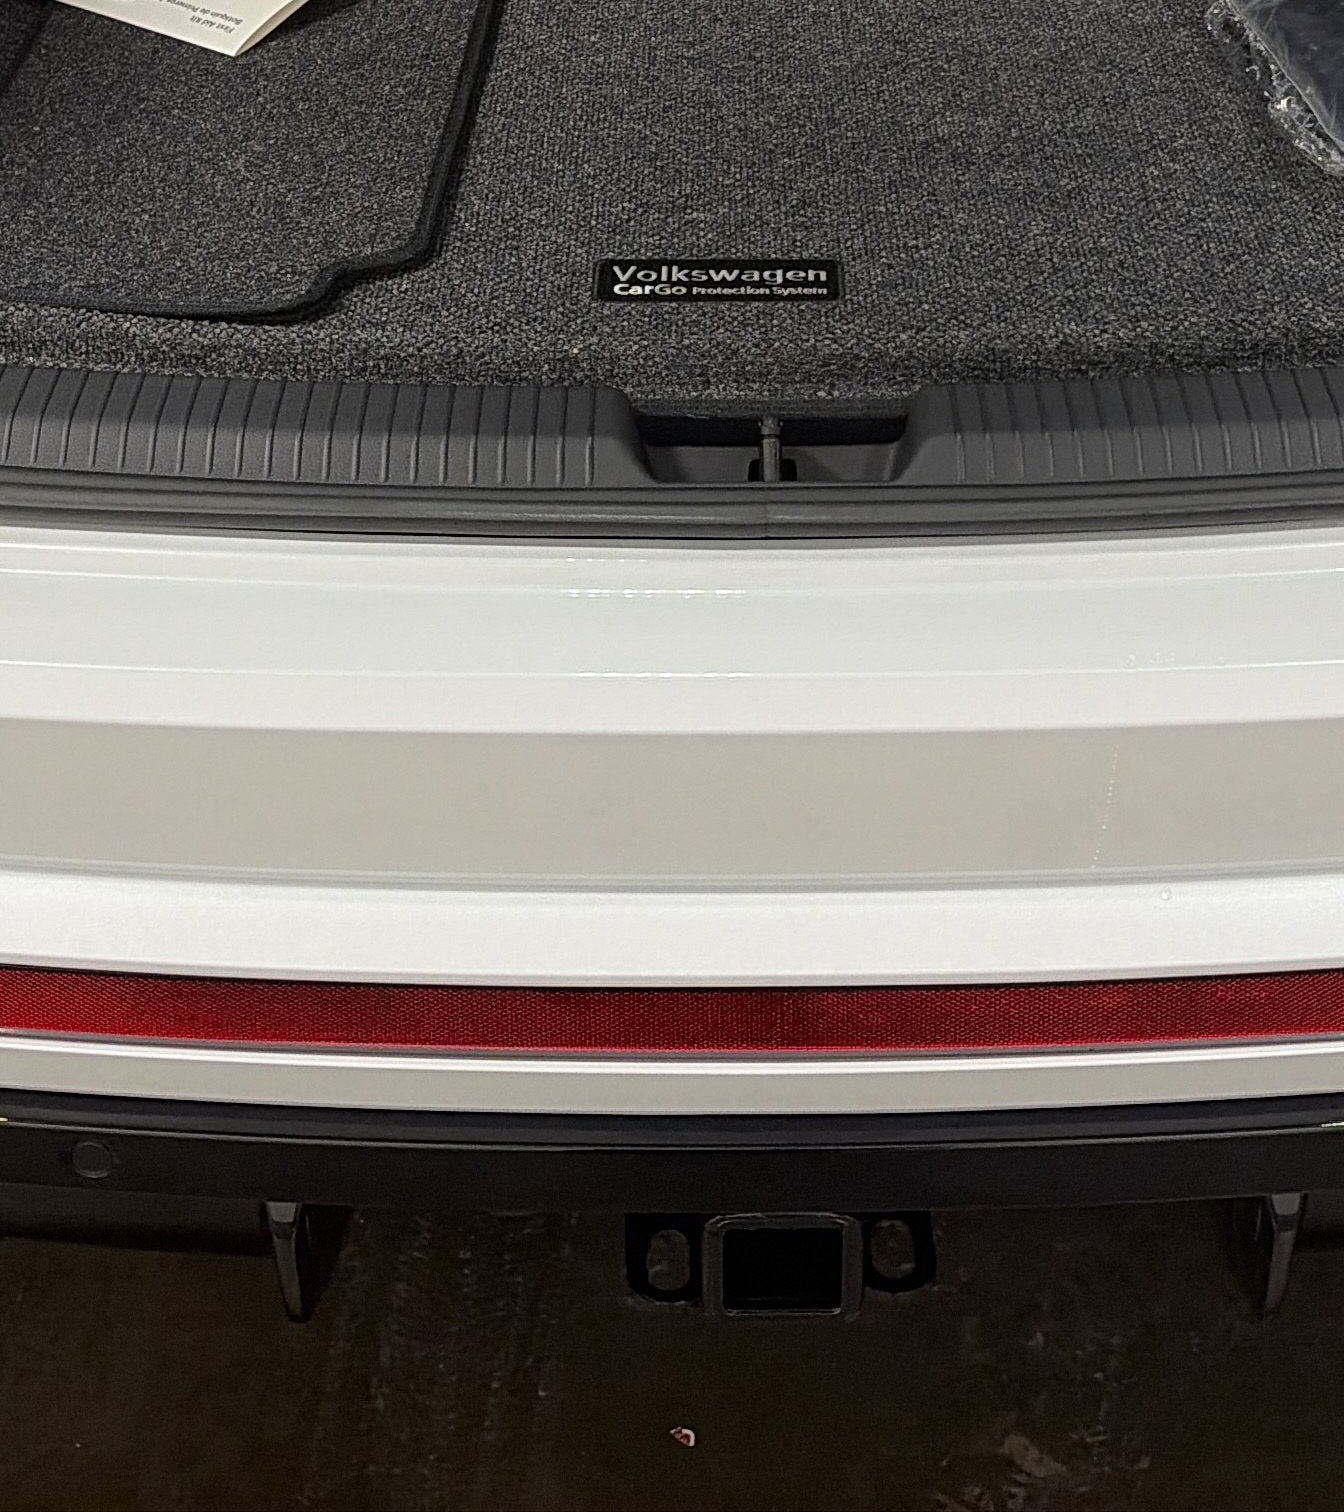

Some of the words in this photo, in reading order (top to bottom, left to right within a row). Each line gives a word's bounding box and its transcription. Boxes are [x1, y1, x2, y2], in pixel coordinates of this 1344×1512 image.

[190, 15, 201, 24] Kit
[201, 19, 215, 28] Aid
[612, 265, 828, 286] Volkswagen
[613, 283, 688, 296] CarGo
[692, 286, 770, 296] Protection
[772, 286, 828, 297] System
